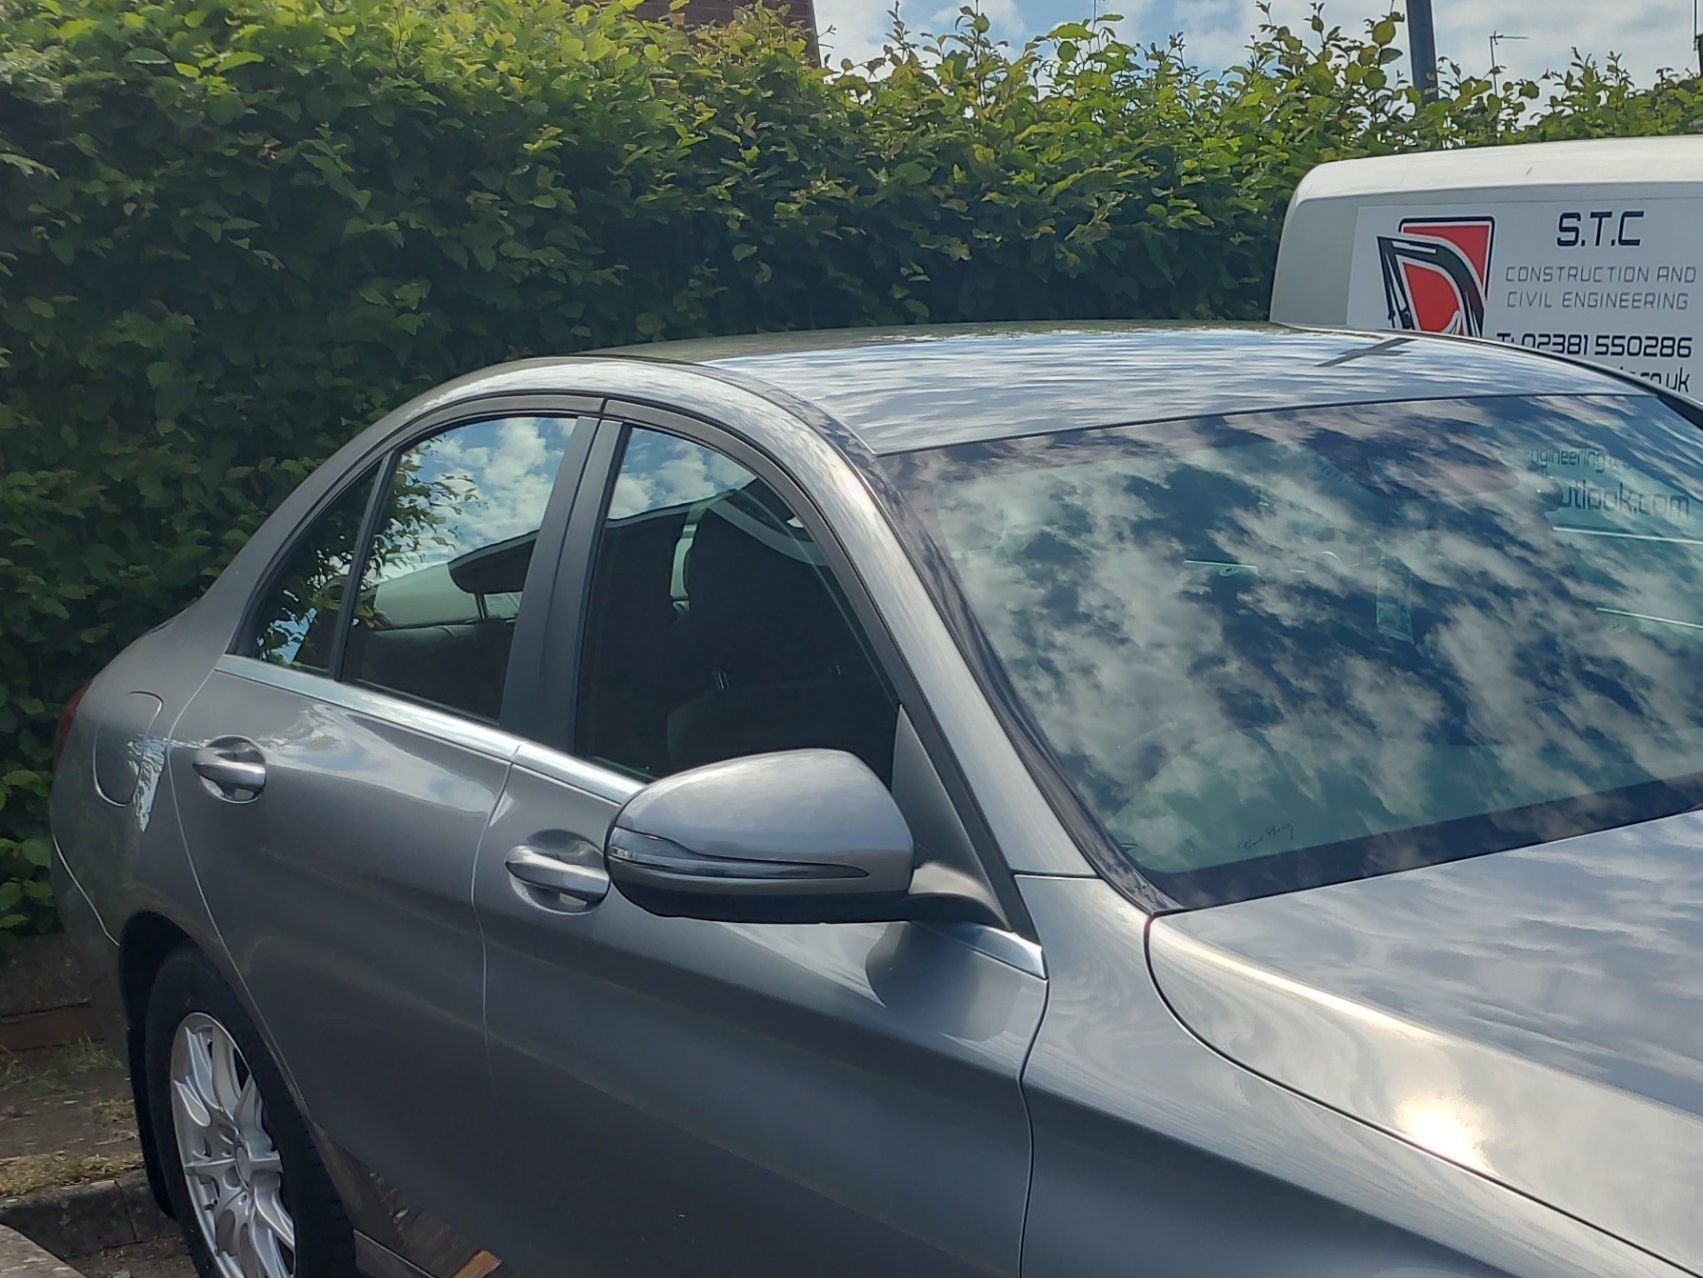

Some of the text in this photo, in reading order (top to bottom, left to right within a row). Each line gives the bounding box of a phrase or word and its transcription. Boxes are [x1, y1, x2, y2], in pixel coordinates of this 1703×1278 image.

[1557, 211, 1644, 246] S.T.C
[1505, 266, 1697, 284] CONSTRUCTION AND
[1506, 291, 1689, 311] CIVIL ENGINEERING
[1522, 333, 1588, 355] 02381
[1594, 335, 1693, 358] 550286
